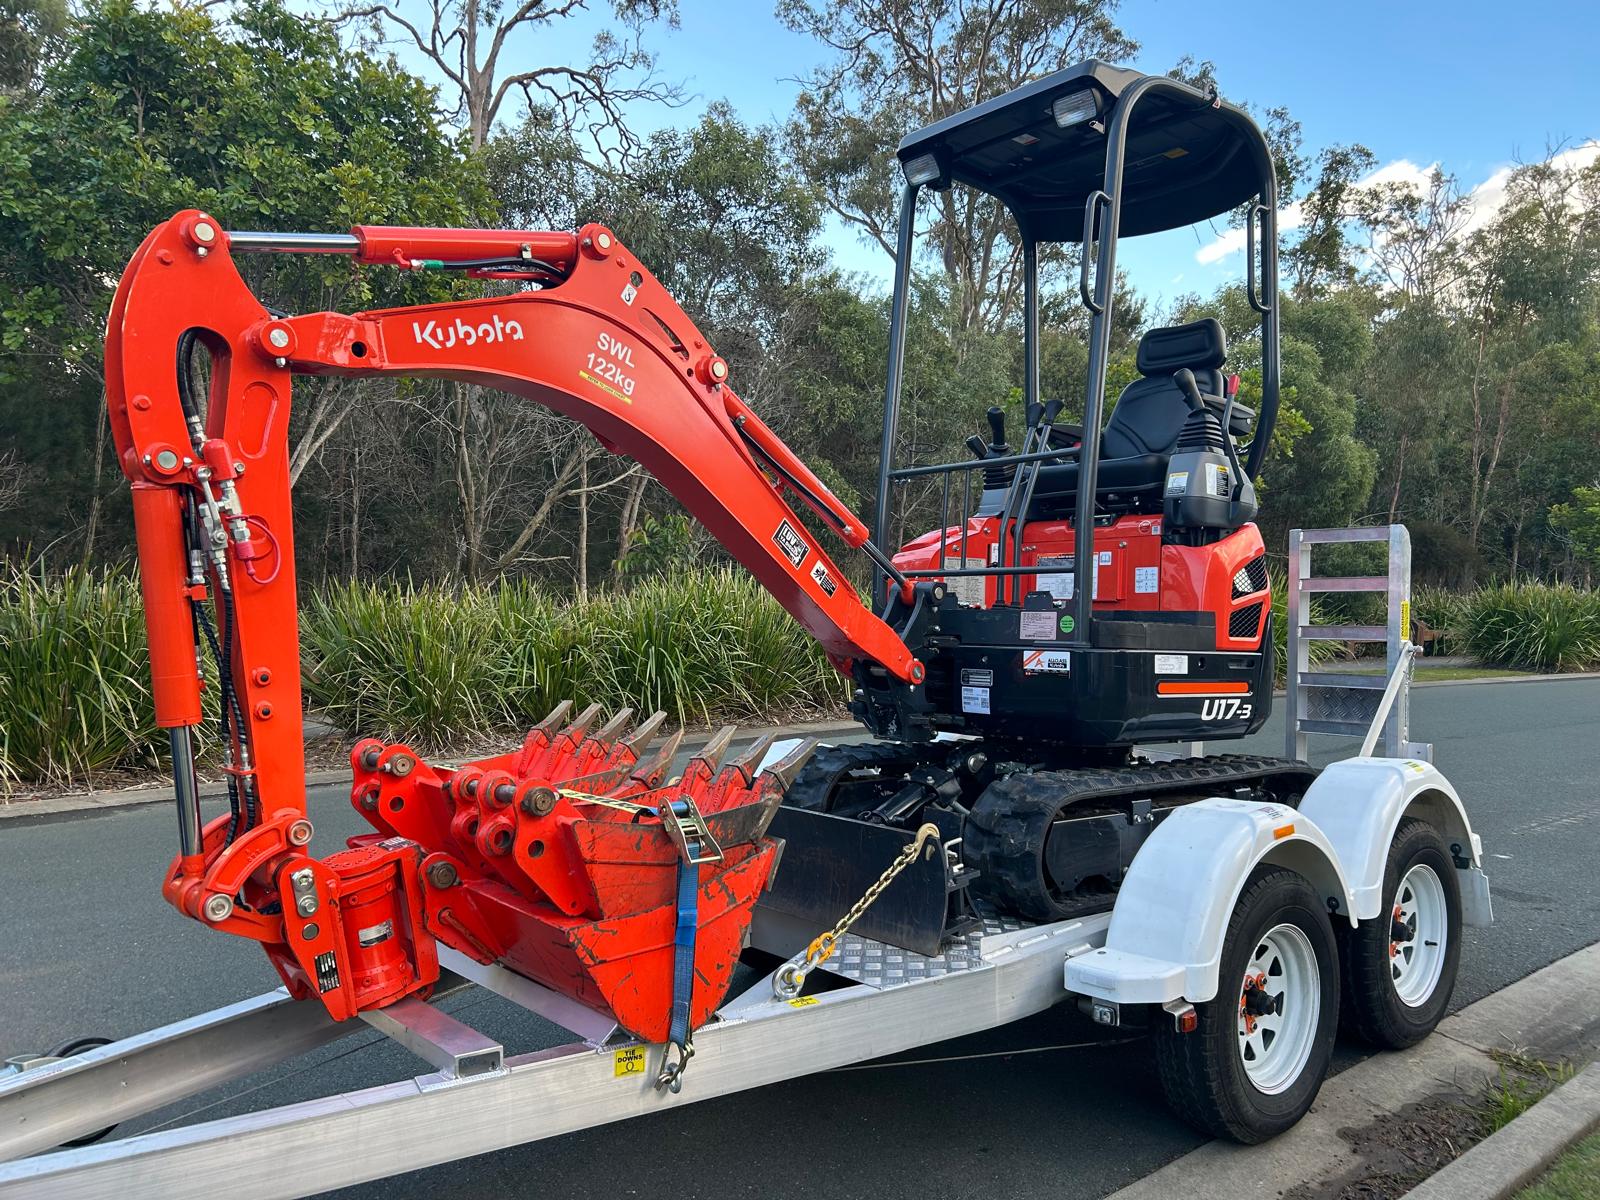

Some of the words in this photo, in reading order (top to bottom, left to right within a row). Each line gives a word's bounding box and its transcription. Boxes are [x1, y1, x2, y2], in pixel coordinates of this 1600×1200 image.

[412, 314, 524, 349] Kubota
[597, 332, 635, 368] SWL
[587, 352, 636, 396] 122kg
[783, 527, 797, 546] LUV
[1201, 699, 1253, 720] U17-3
[617, 1054, 643, 1063] DOWNS
[625, 1049, 636, 1057] TIE
